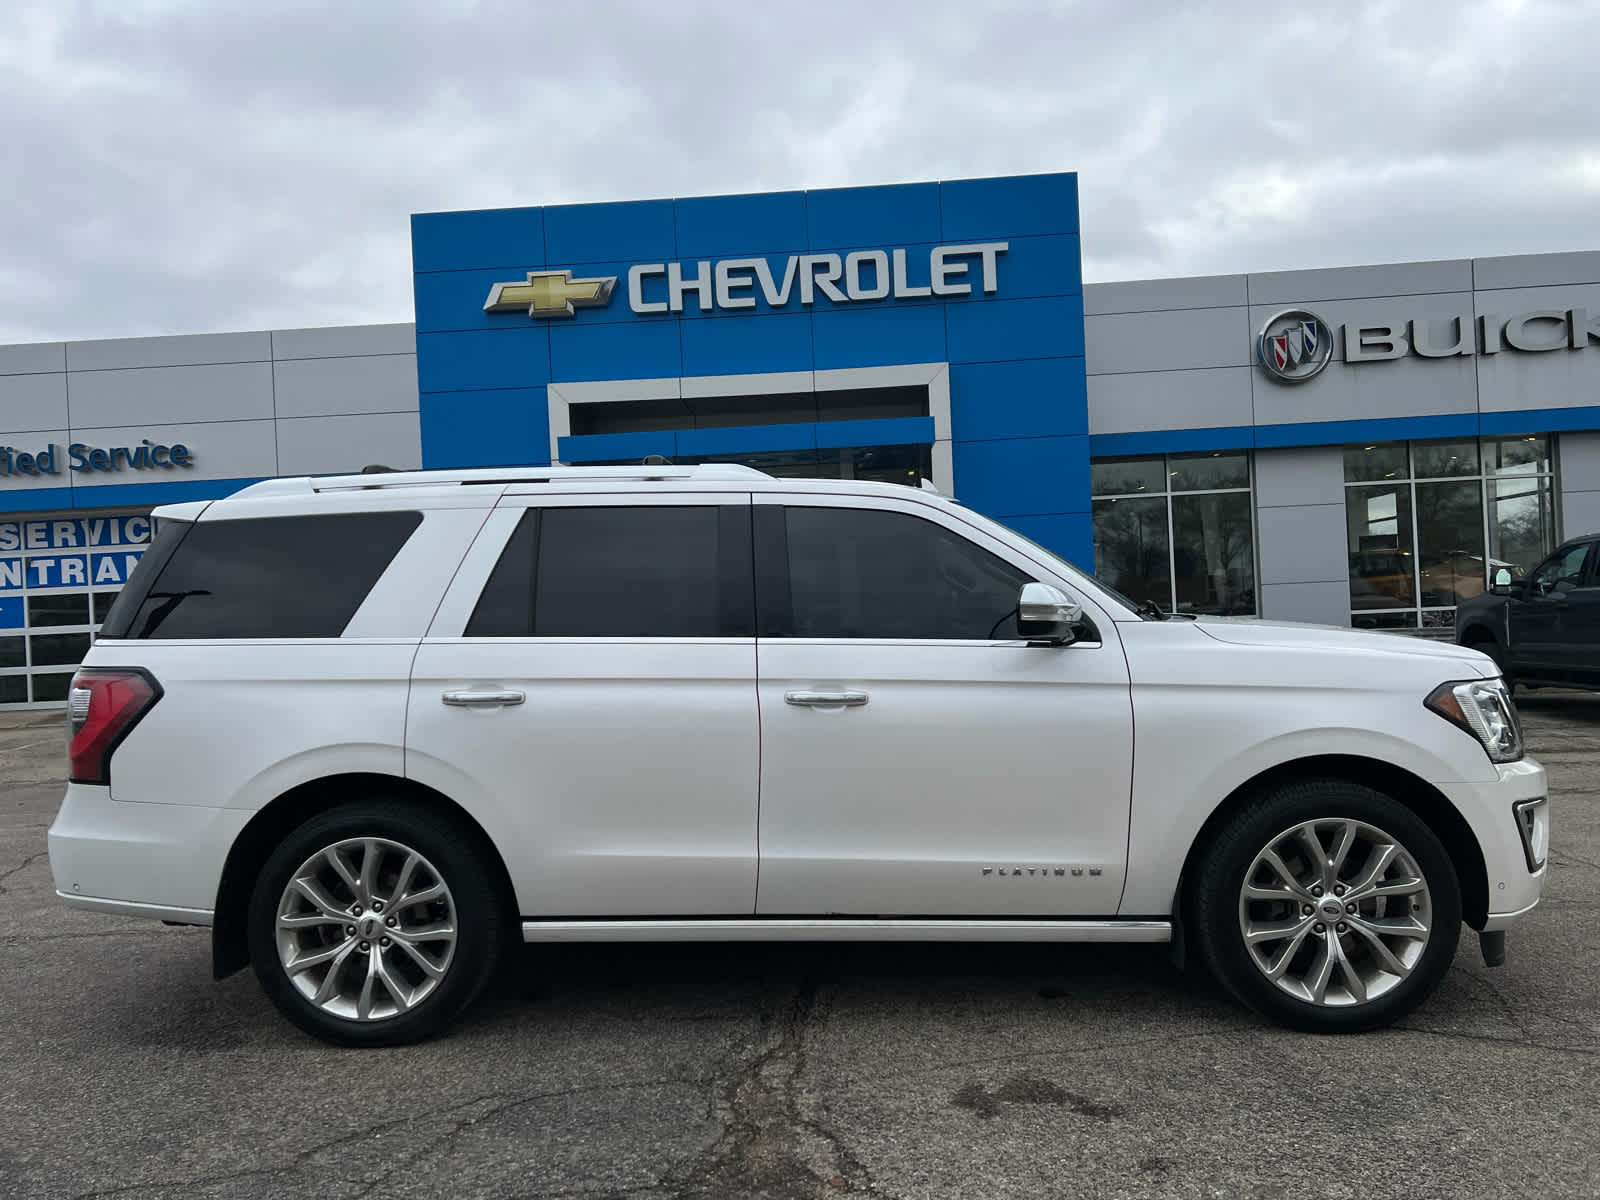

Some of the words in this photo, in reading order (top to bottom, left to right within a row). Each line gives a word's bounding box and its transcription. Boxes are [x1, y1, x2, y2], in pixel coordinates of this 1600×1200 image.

[628, 241, 1009, 314] CHEVROLET
[68, 439, 189, 472] Service
[0, 516, 161, 550] SERVIC
[982, 866, 1103, 877] PLATINUM
